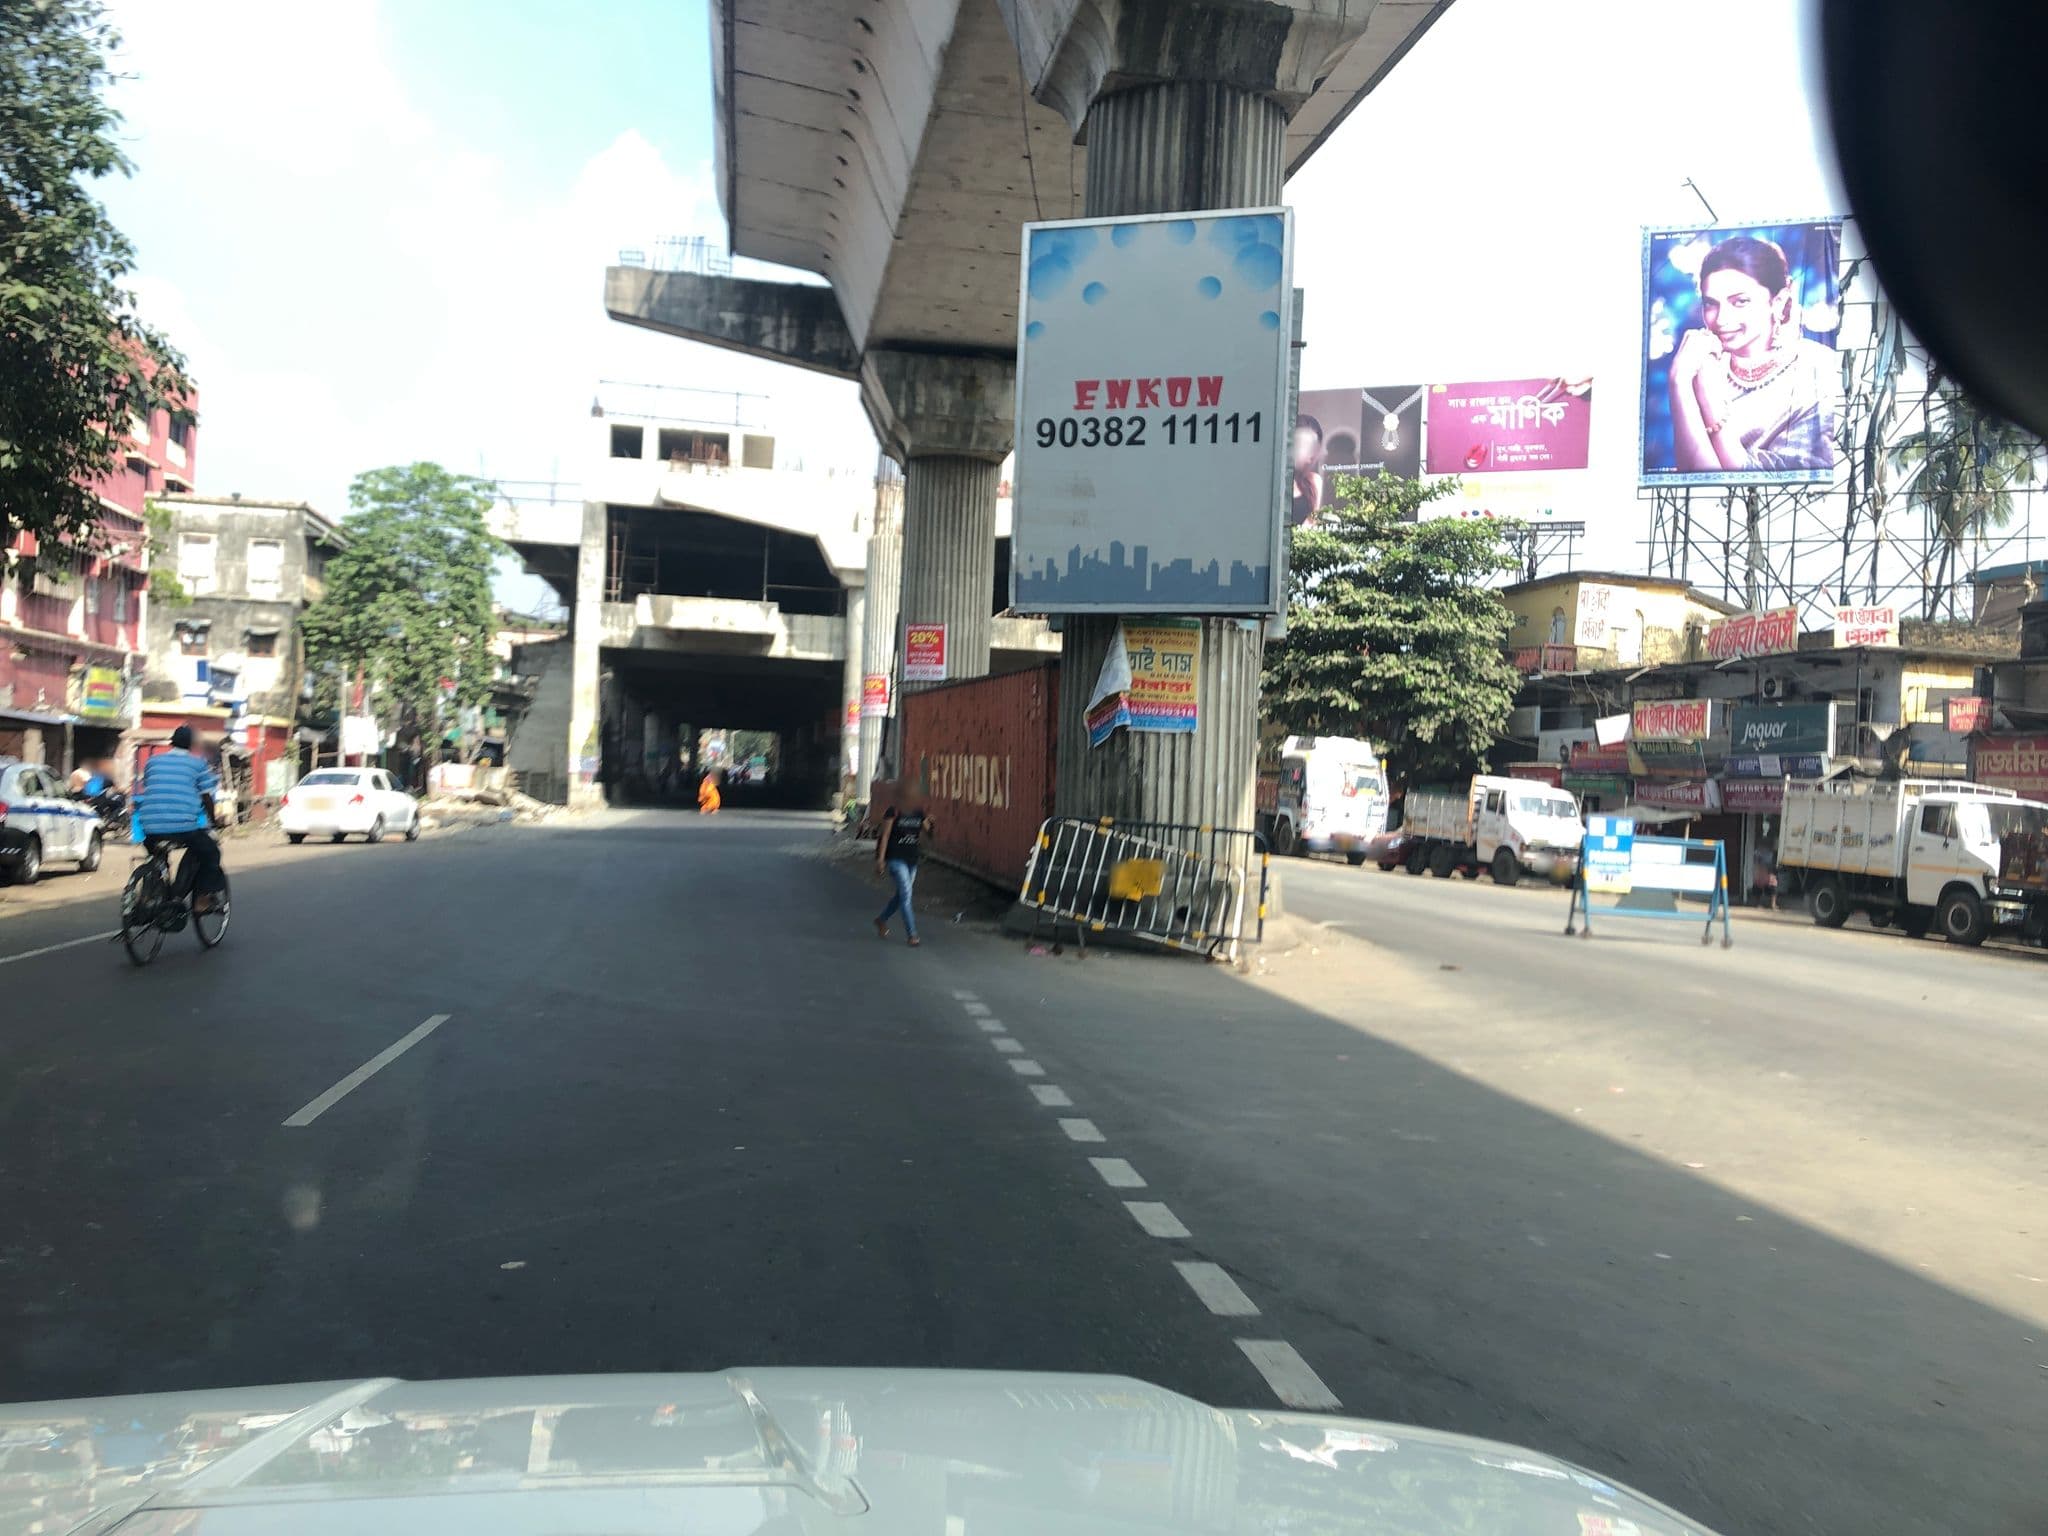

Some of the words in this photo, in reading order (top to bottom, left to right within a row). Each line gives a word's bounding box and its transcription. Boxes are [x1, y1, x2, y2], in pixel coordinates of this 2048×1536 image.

[1073, 376, 1224, 410] ENKON
[1036, 415, 1146, 448] 90382
[1161, 411, 1261, 445] 11111
[910, 632, 939, 644] 20%
[930, 752, 1010, 811] HYUNDAI
